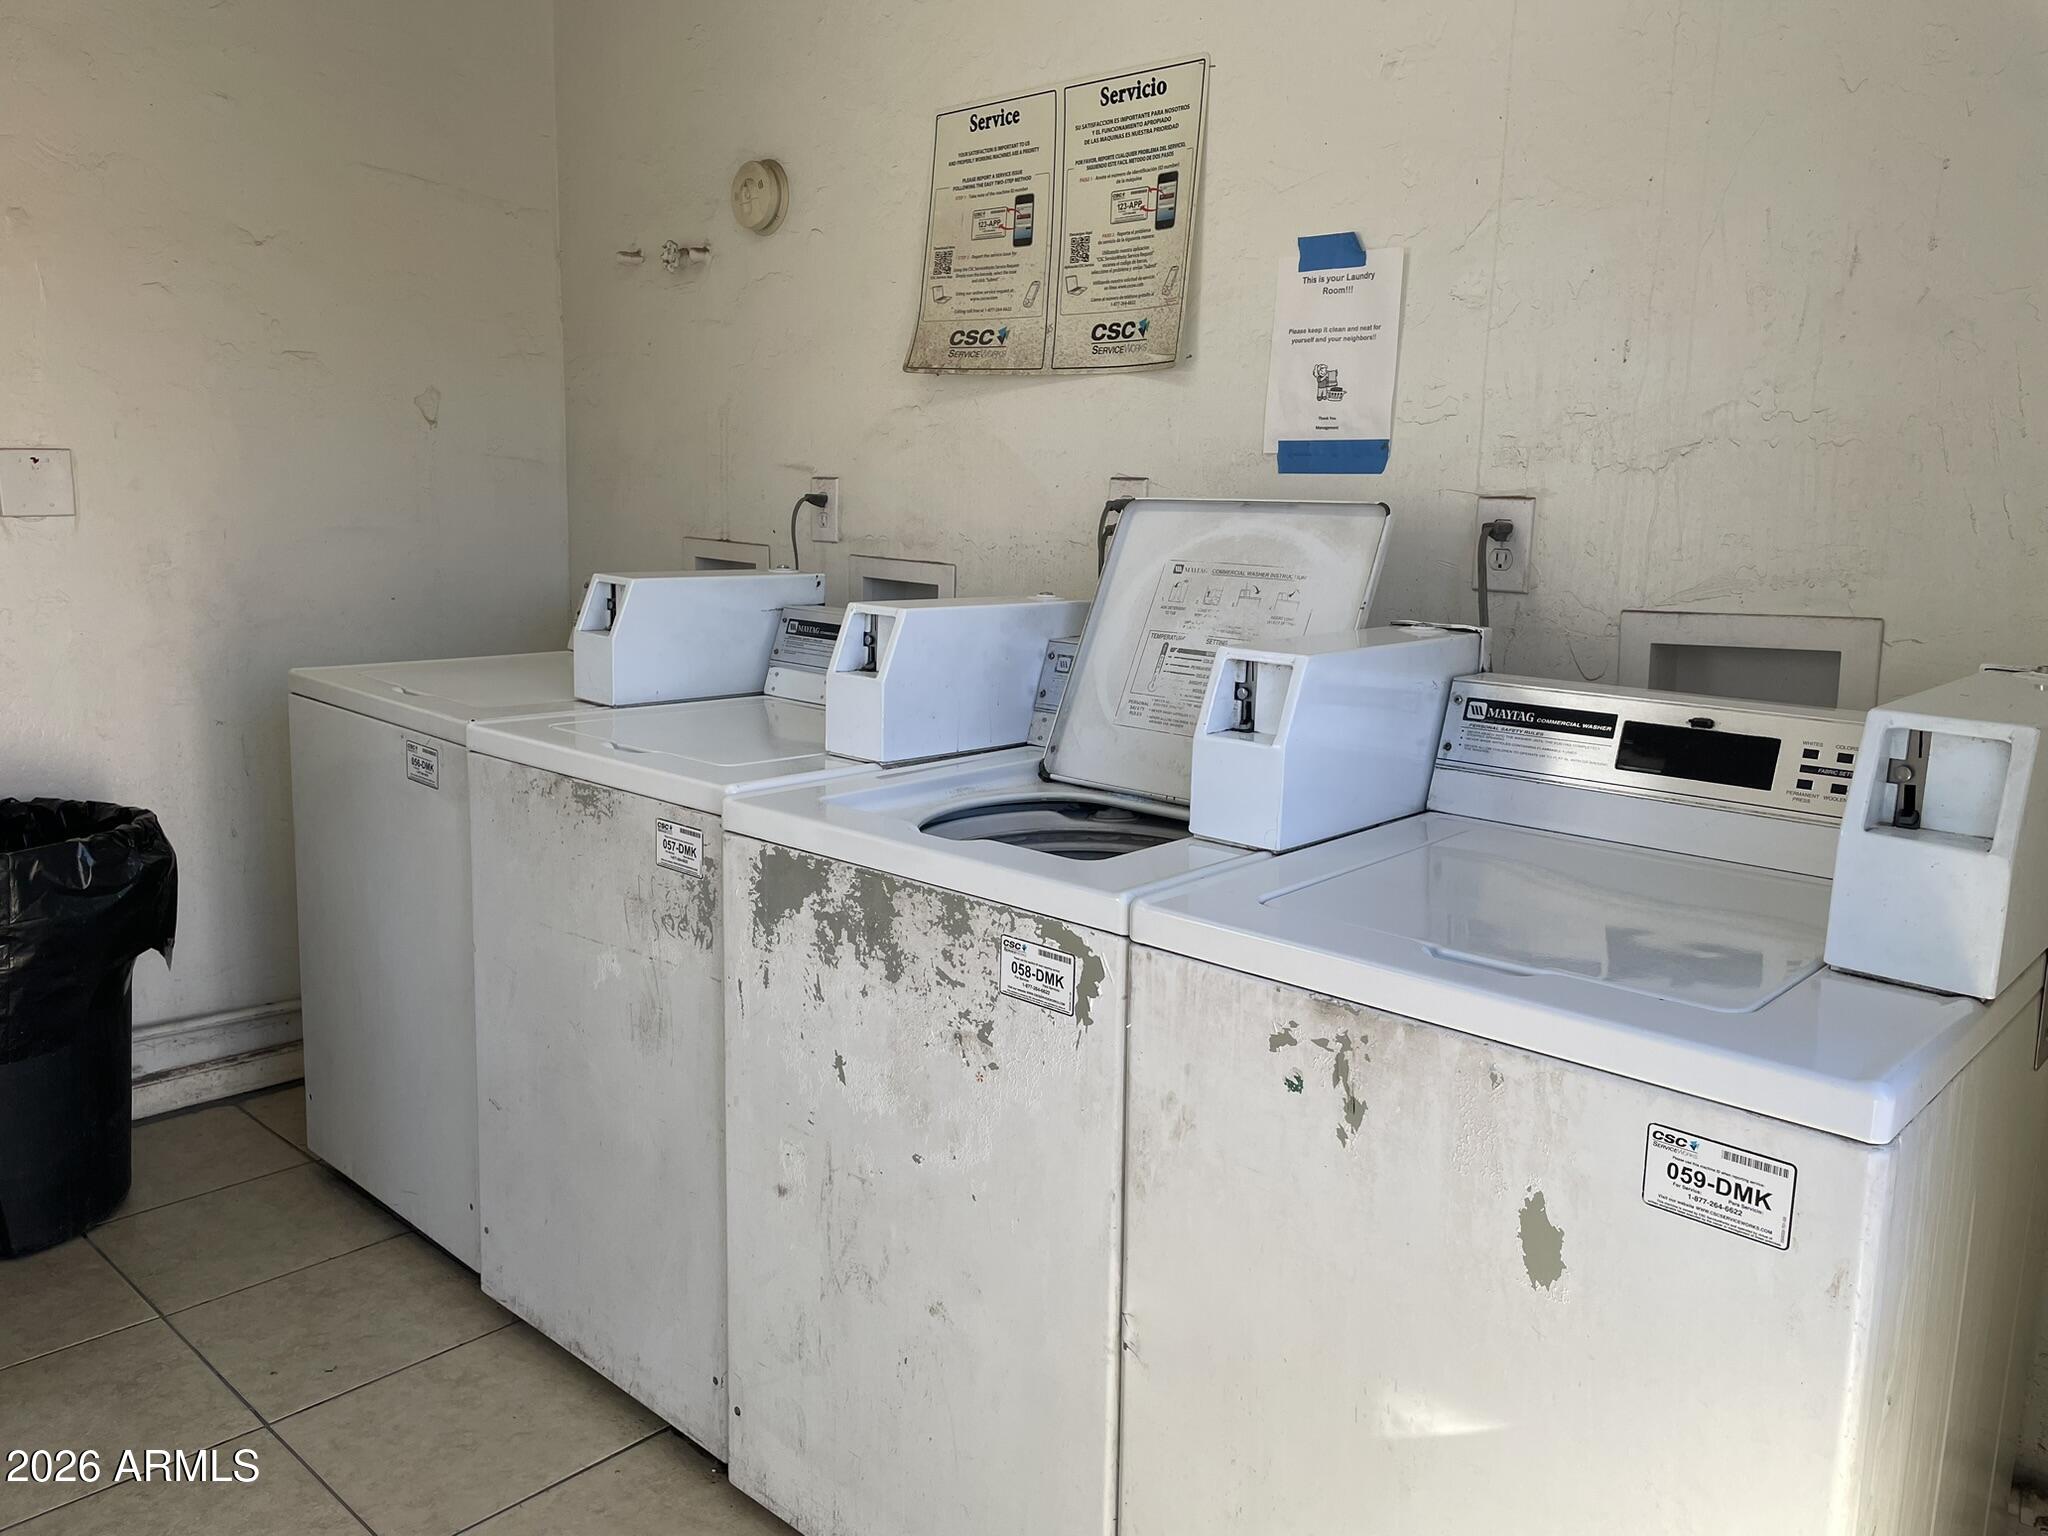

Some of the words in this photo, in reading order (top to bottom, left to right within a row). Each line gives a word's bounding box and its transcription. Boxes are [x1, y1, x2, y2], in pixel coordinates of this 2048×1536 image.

[1100, 77, 1167, 106] Servicio
[970, 108, 1020, 132] Service
[1120, 113, 1150, 122] IMPORTANTE
[1165, 104, 1190, 114] NOSOTROS
[1100, 133, 1124, 142] MAQUINAS
[1132, 127, 1153, 136] NUESTRA
[1154, 123, 1179, 132] PRIORIDAD
[1102, 122, 1143, 134] FUNCIONAMIENTO
[1144, 116, 1172, 126] APROPIADO
[1138, 147, 1159, 155] PROBLEMA
[1118, 201, 1142, 210] 123-APP
[1302, 276, 1317, 284] This
[1326, 276, 1344, 284] your
[1346, 272, 1375, 281] Laundry
[1323, 286, 1353, 294] Room!!!
[949, 329, 994, 346] CSC
[1091, 321, 1136, 341] CSC
[1487, 708, 1535, 722] MAYTAG
[1536, 718, 1581, 728] COMMERCIAL
[1582, 722, 1612, 732] WASHER
[1786, 790, 1819, 799] PERMANENT
[663, 839, 696, 858] 057-DMK
[1003, 940, 1021, 950] CSC
[1011, 961, 1064, 989] 058-DMK
[1652, 1130, 1688, 1148] CSC
[1667, 1162, 1773, 1211] 059-DMK
[1688, 1194, 1742, 1216] 1-877-264-6622
